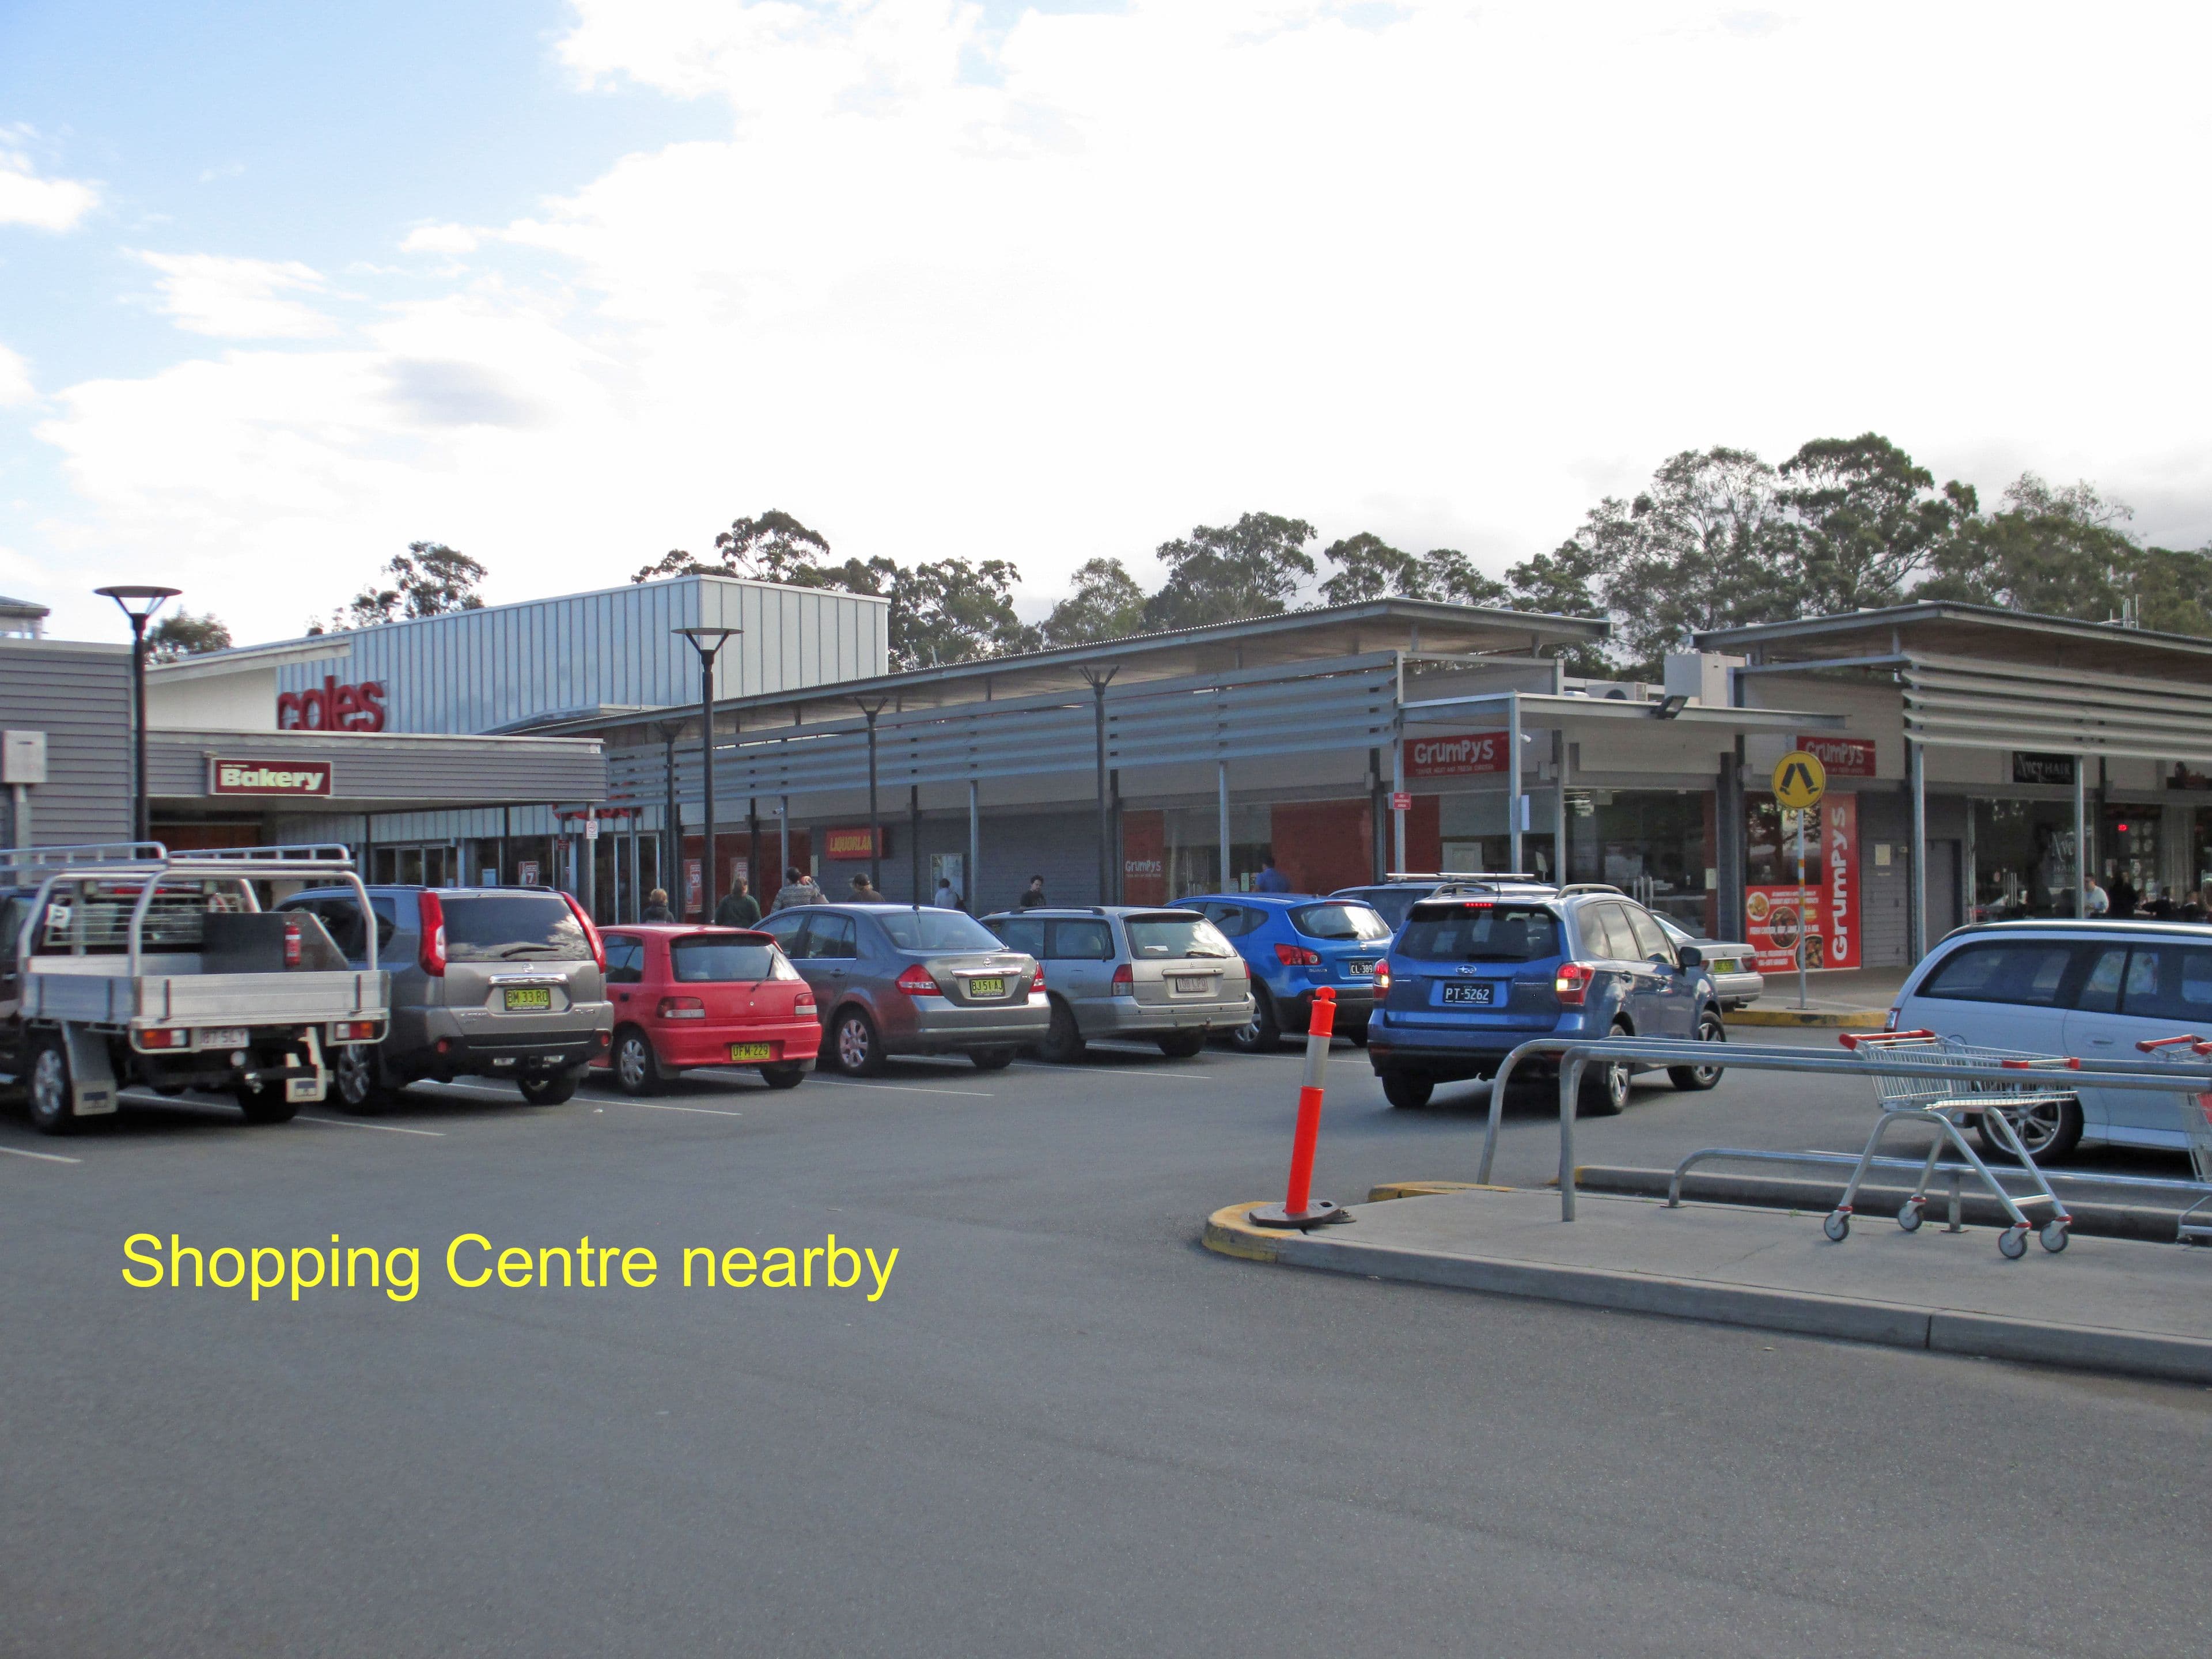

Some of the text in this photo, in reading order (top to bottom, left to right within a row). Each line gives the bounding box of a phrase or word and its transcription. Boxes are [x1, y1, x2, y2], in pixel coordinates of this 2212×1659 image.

[278, 675, 384, 732] coles
[221, 768, 324, 790] Bakery
[522, 991, 533, 1002] 33
[1445, 987, 1490, 1001] PT-5262
